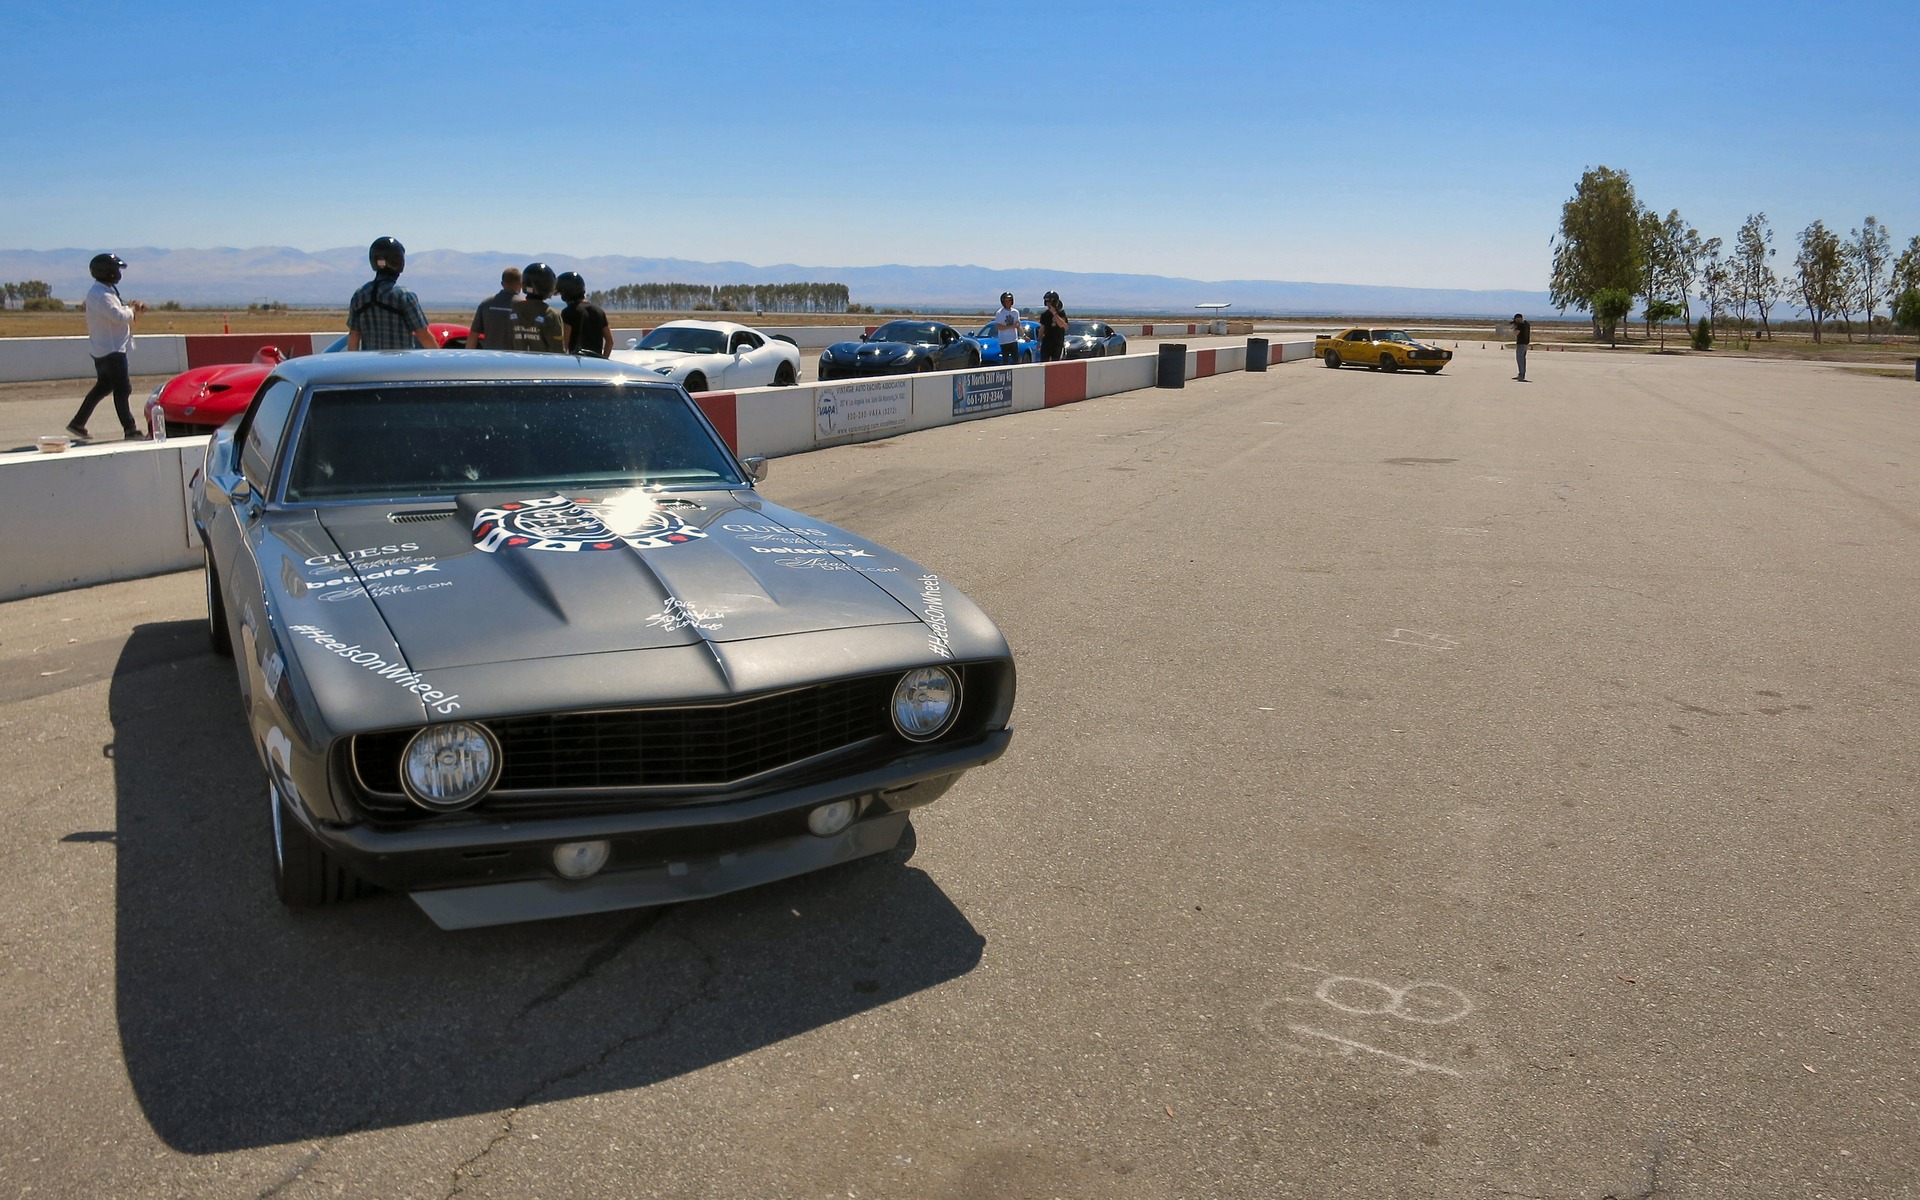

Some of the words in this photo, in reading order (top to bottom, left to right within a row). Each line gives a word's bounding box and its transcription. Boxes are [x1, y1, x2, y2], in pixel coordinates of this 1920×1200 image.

[971, 373, 985, 387] North
[985, 371, 996, 385] EXIT
[996, 370, 1006, 386] Hwy
[836, 385, 855, 395] VINTAGE
[855, 384, 866, 393] AUTO
[866, 382, 881, 392] RACING
[882, 380, 906, 391] ASSOCIATION
[819, 405, 836, 416] VARA
[721, 523, 828, 537] GUESS
[304, 542, 420, 566] GUESS
[663, 596, 697, 614] 2015
[917, 574, 950, 659] #HeelsOnWheels
[288, 624, 461, 715] #HeelsOnWheels
